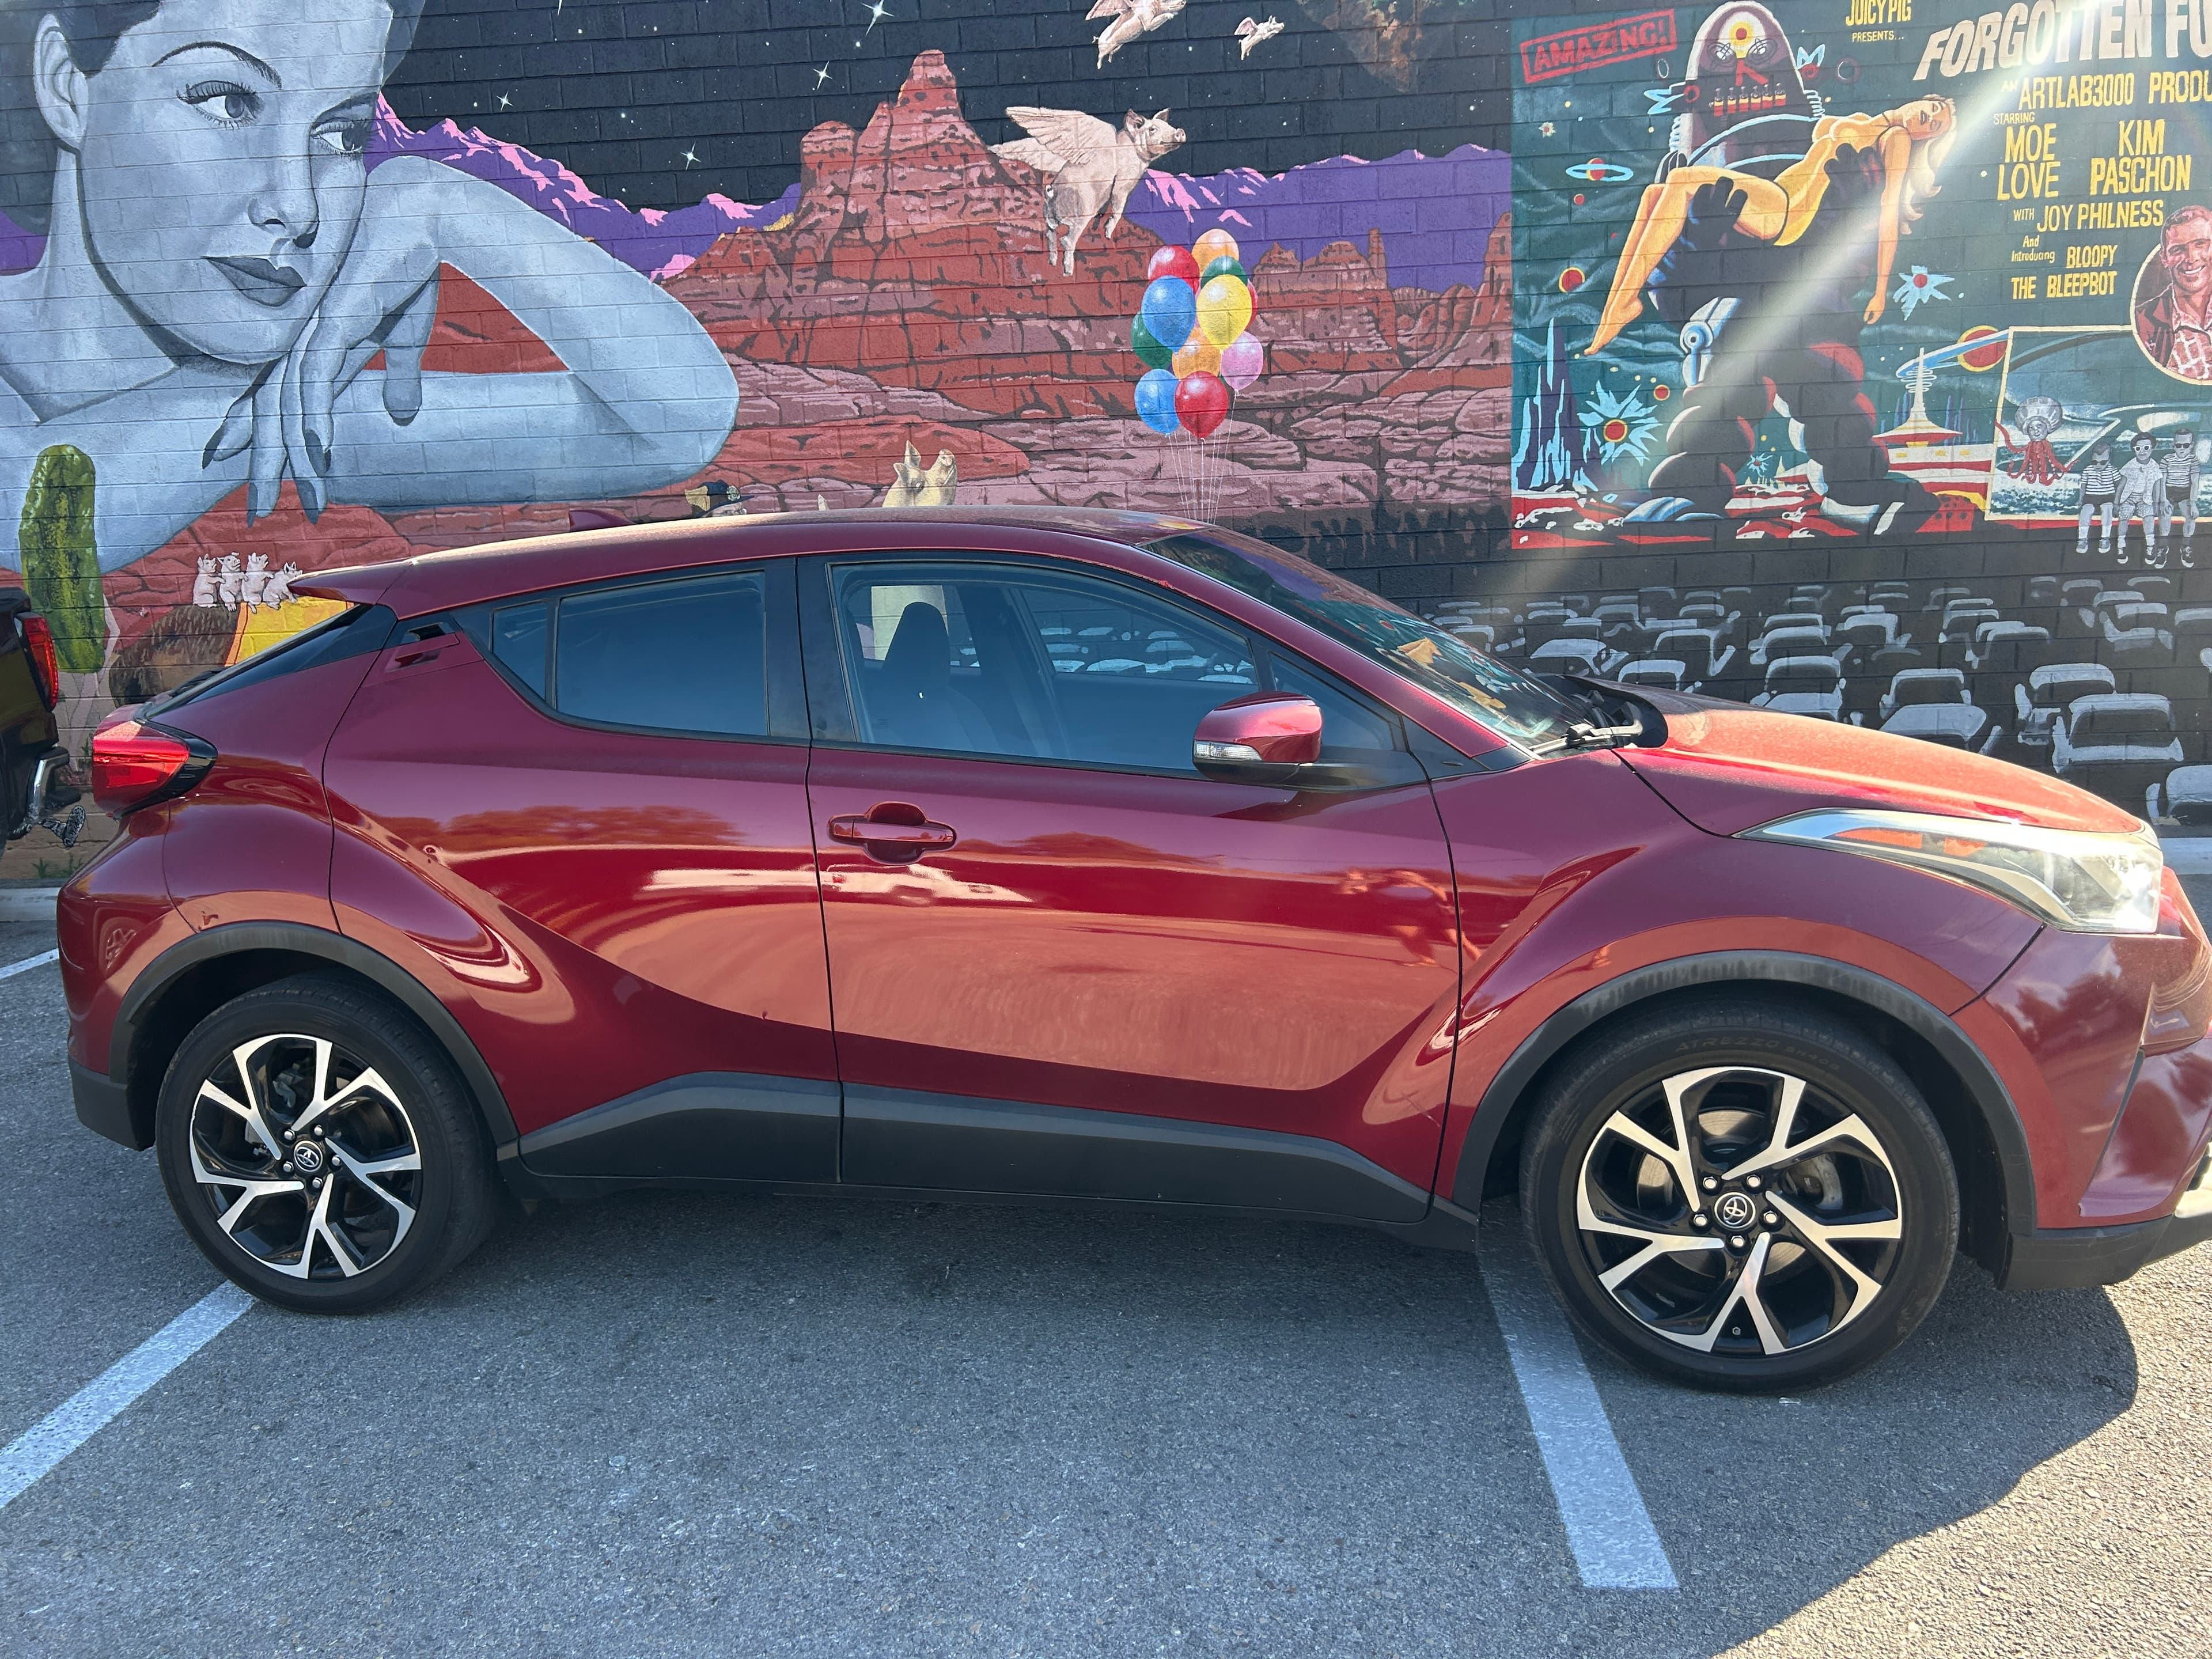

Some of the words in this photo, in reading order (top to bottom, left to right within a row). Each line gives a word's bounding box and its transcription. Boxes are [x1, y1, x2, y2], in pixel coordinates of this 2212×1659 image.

[1846, 0, 1887, 26] JUICY
[1887, 0, 1911, 23] PIG
[1533, 19, 1668, 73] AMAZING!
[1852, 31, 1904, 43] PRESENTS...
[1912, 0, 2152, 81] FORGOTTEN
[2018, 73, 2135, 110] ARTLAB3000
[1993, 112, 2035, 125] STARRING
[2005, 123, 2056, 163] MOE
[2118, 119, 2165, 157] KIM
[1997, 161, 2061, 200] LOVE
[2089, 154, 2192, 195] PASCHON
[2013, 207, 2035, 221] WITH
[2037, 204, 2074, 232] JOY
[2077, 199, 2164, 230] PHILNESS
[2011, 248, 2055, 263] Introducing
[2022, 235, 2040, 248] And
[2066, 244, 2118, 268] BLOOPY
[2010, 276, 2036, 300] THE
[2046, 271, 2118, 298] BLEEPBOT
